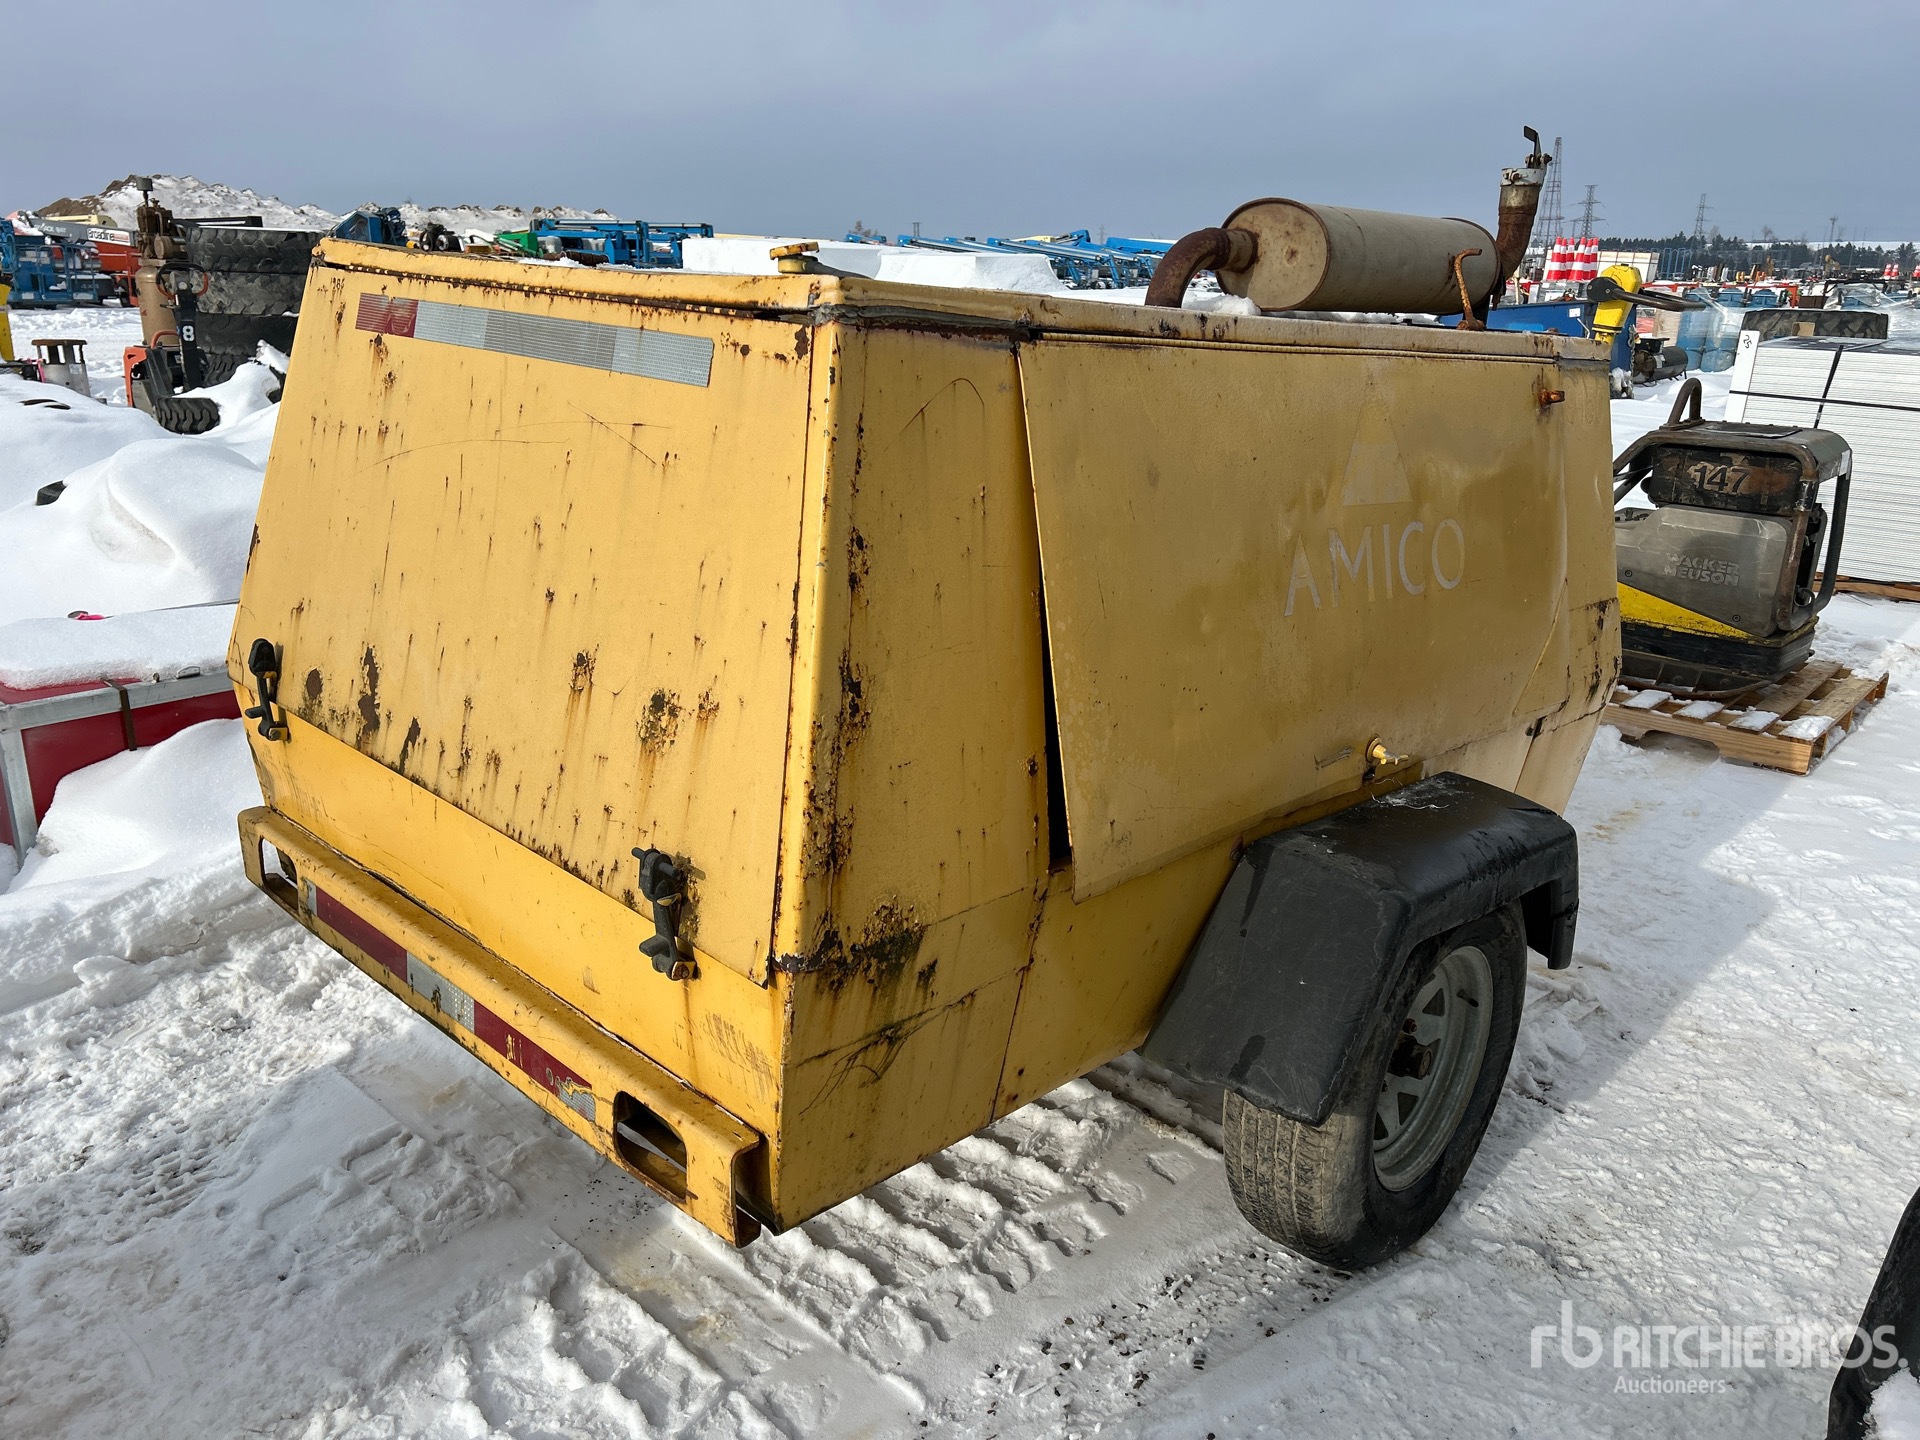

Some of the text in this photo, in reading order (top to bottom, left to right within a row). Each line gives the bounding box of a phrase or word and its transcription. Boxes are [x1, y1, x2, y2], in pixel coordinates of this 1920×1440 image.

[182, 325, 195, 341] 8
[1694, 465, 1751, 493] 147
[1284, 518, 1466, 616] AMICO
